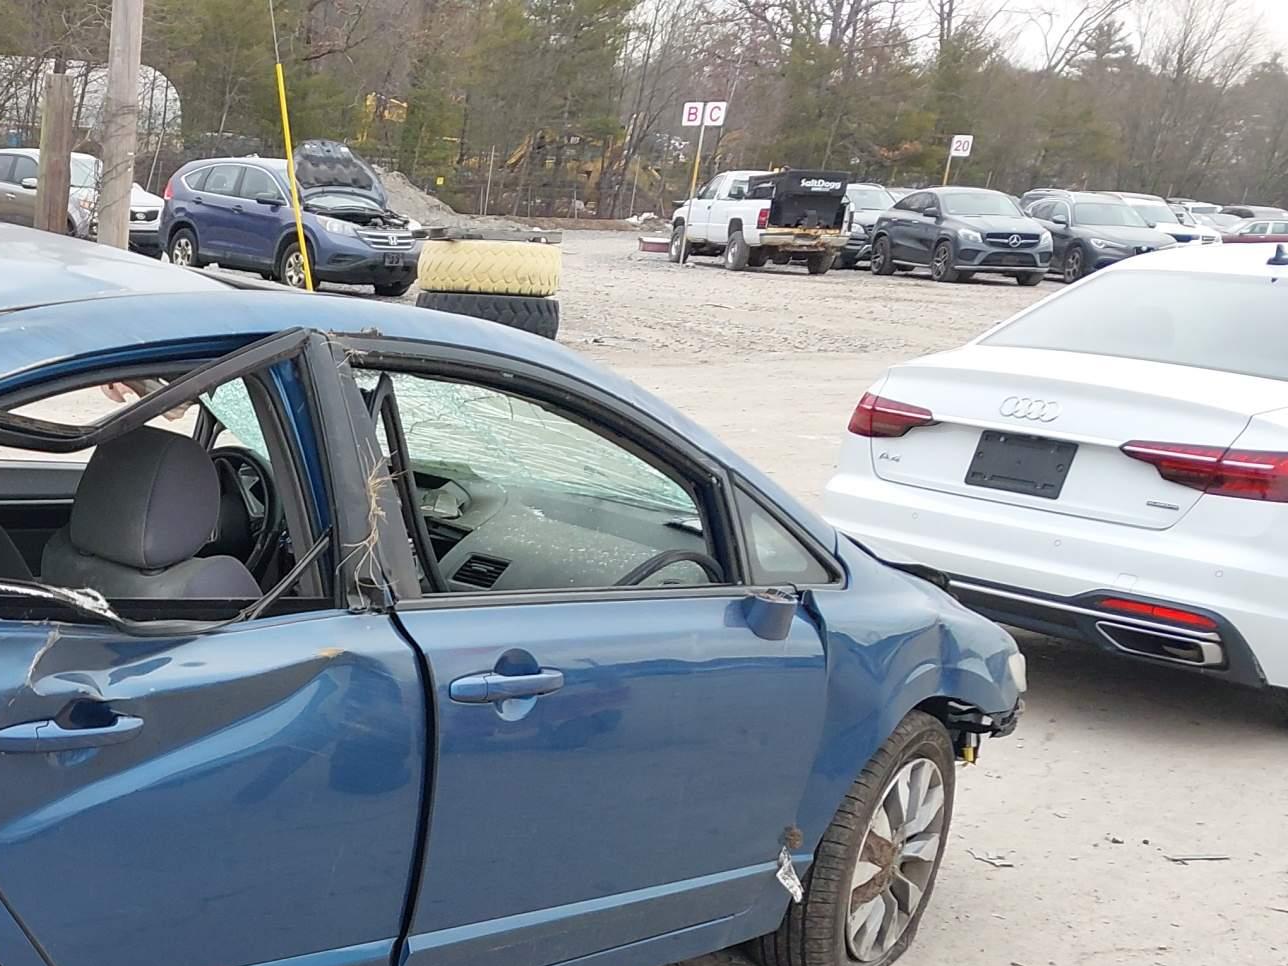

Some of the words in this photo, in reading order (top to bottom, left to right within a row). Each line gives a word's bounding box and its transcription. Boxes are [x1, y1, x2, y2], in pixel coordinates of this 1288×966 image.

[687, 106, 698, 122] B
[710, 106, 721, 122] C
[953, 140, 970, 152] 20
[800, 178, 842, 190] SaltDogg
